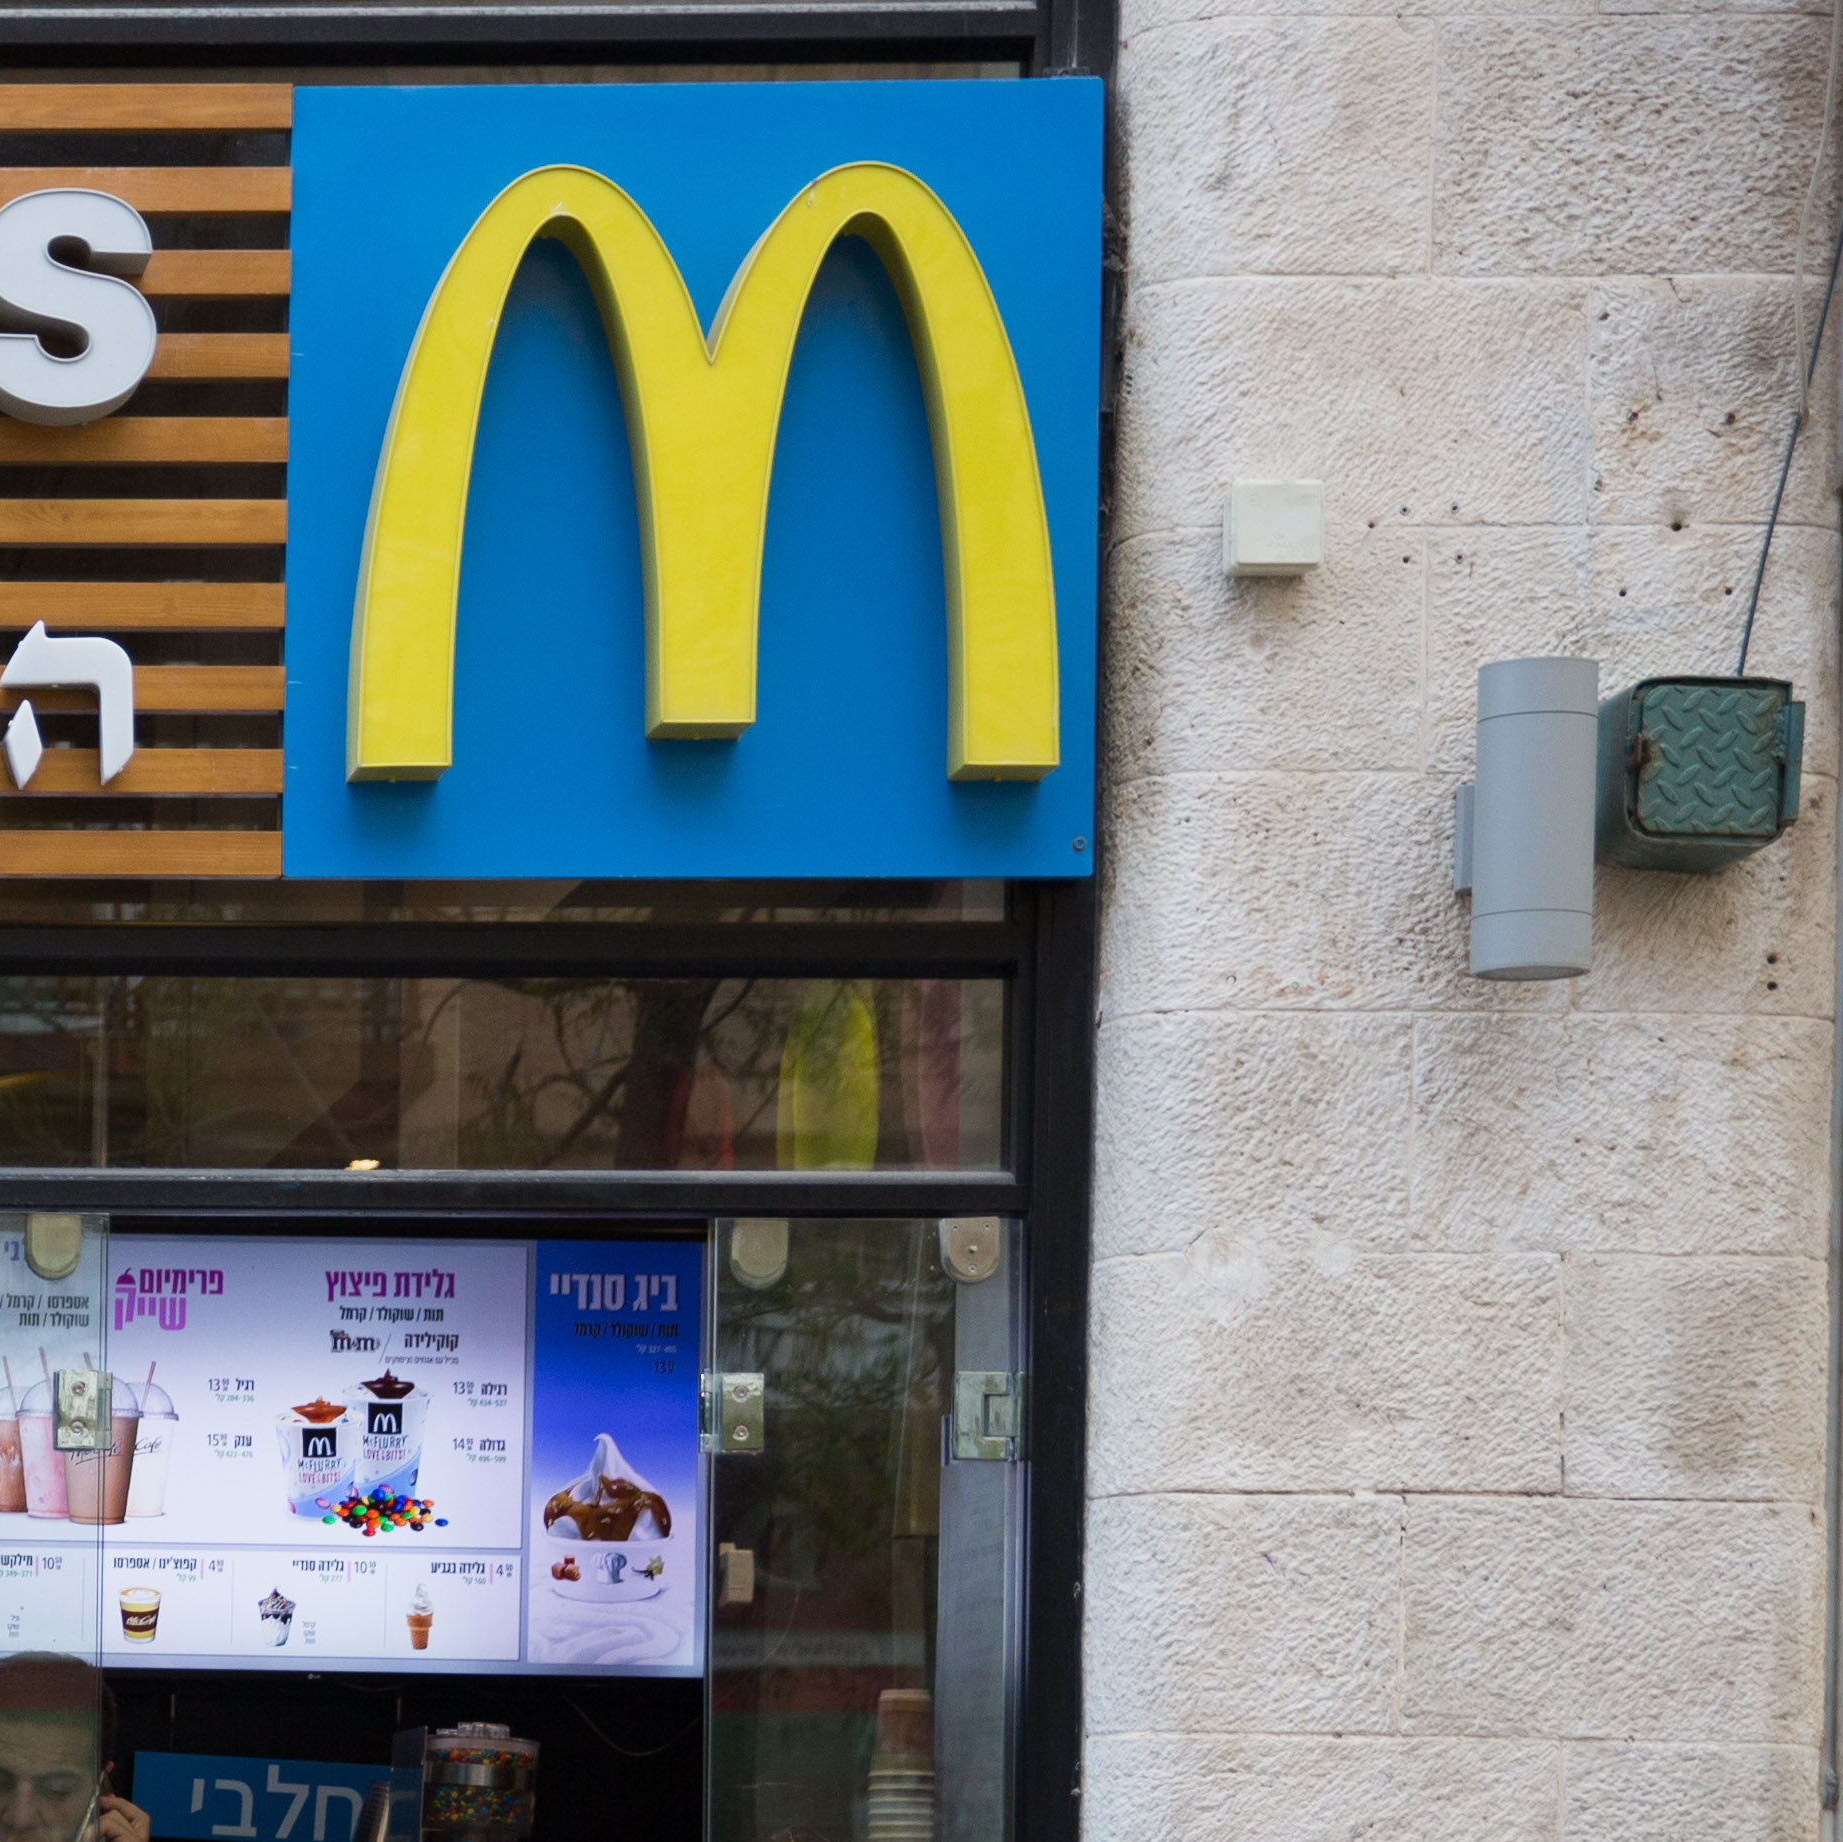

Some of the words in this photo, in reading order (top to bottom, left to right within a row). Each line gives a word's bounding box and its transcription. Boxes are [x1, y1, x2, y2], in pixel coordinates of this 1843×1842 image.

[139, 1268, 224, 1295] פרימיום
[325, 1270, 388, 1302] פיצוץ
[393, 1268, 455, 1299] גלידת
[549, 1273, 626, 1312] סנדיי
[631, 1274, 679, 1313] ביג
[18, 1313, 40, 1327] תות
[49, 1312, 90, 1329] שוקולד
[190, 1763, 365, 1841] חלבי
